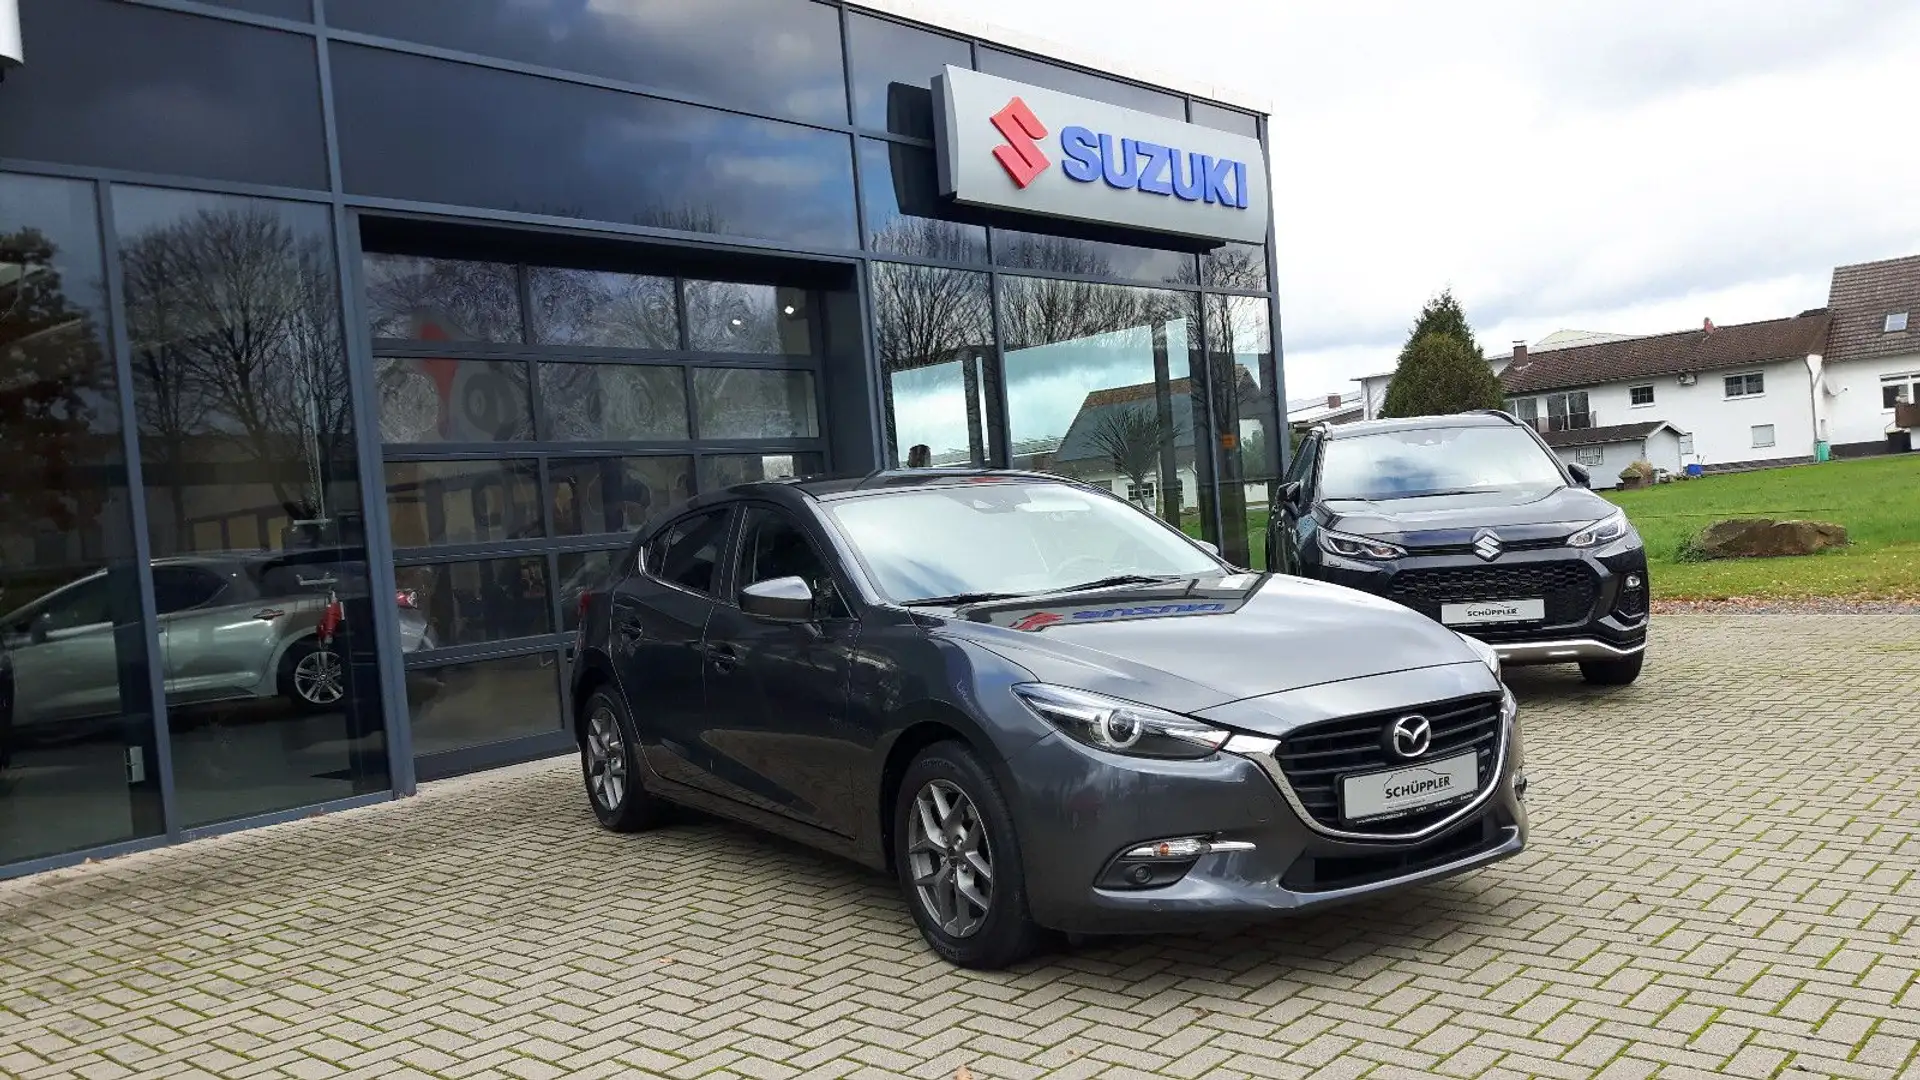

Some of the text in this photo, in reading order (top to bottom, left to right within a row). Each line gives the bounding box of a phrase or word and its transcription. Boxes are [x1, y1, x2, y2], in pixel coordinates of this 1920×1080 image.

[1061, 126, 1248, 208] SUZUKI
[1467, 608, 1517, 617] SCHÜPPLER
[1385, 776, 1451, 799] SCHÜPPLER
